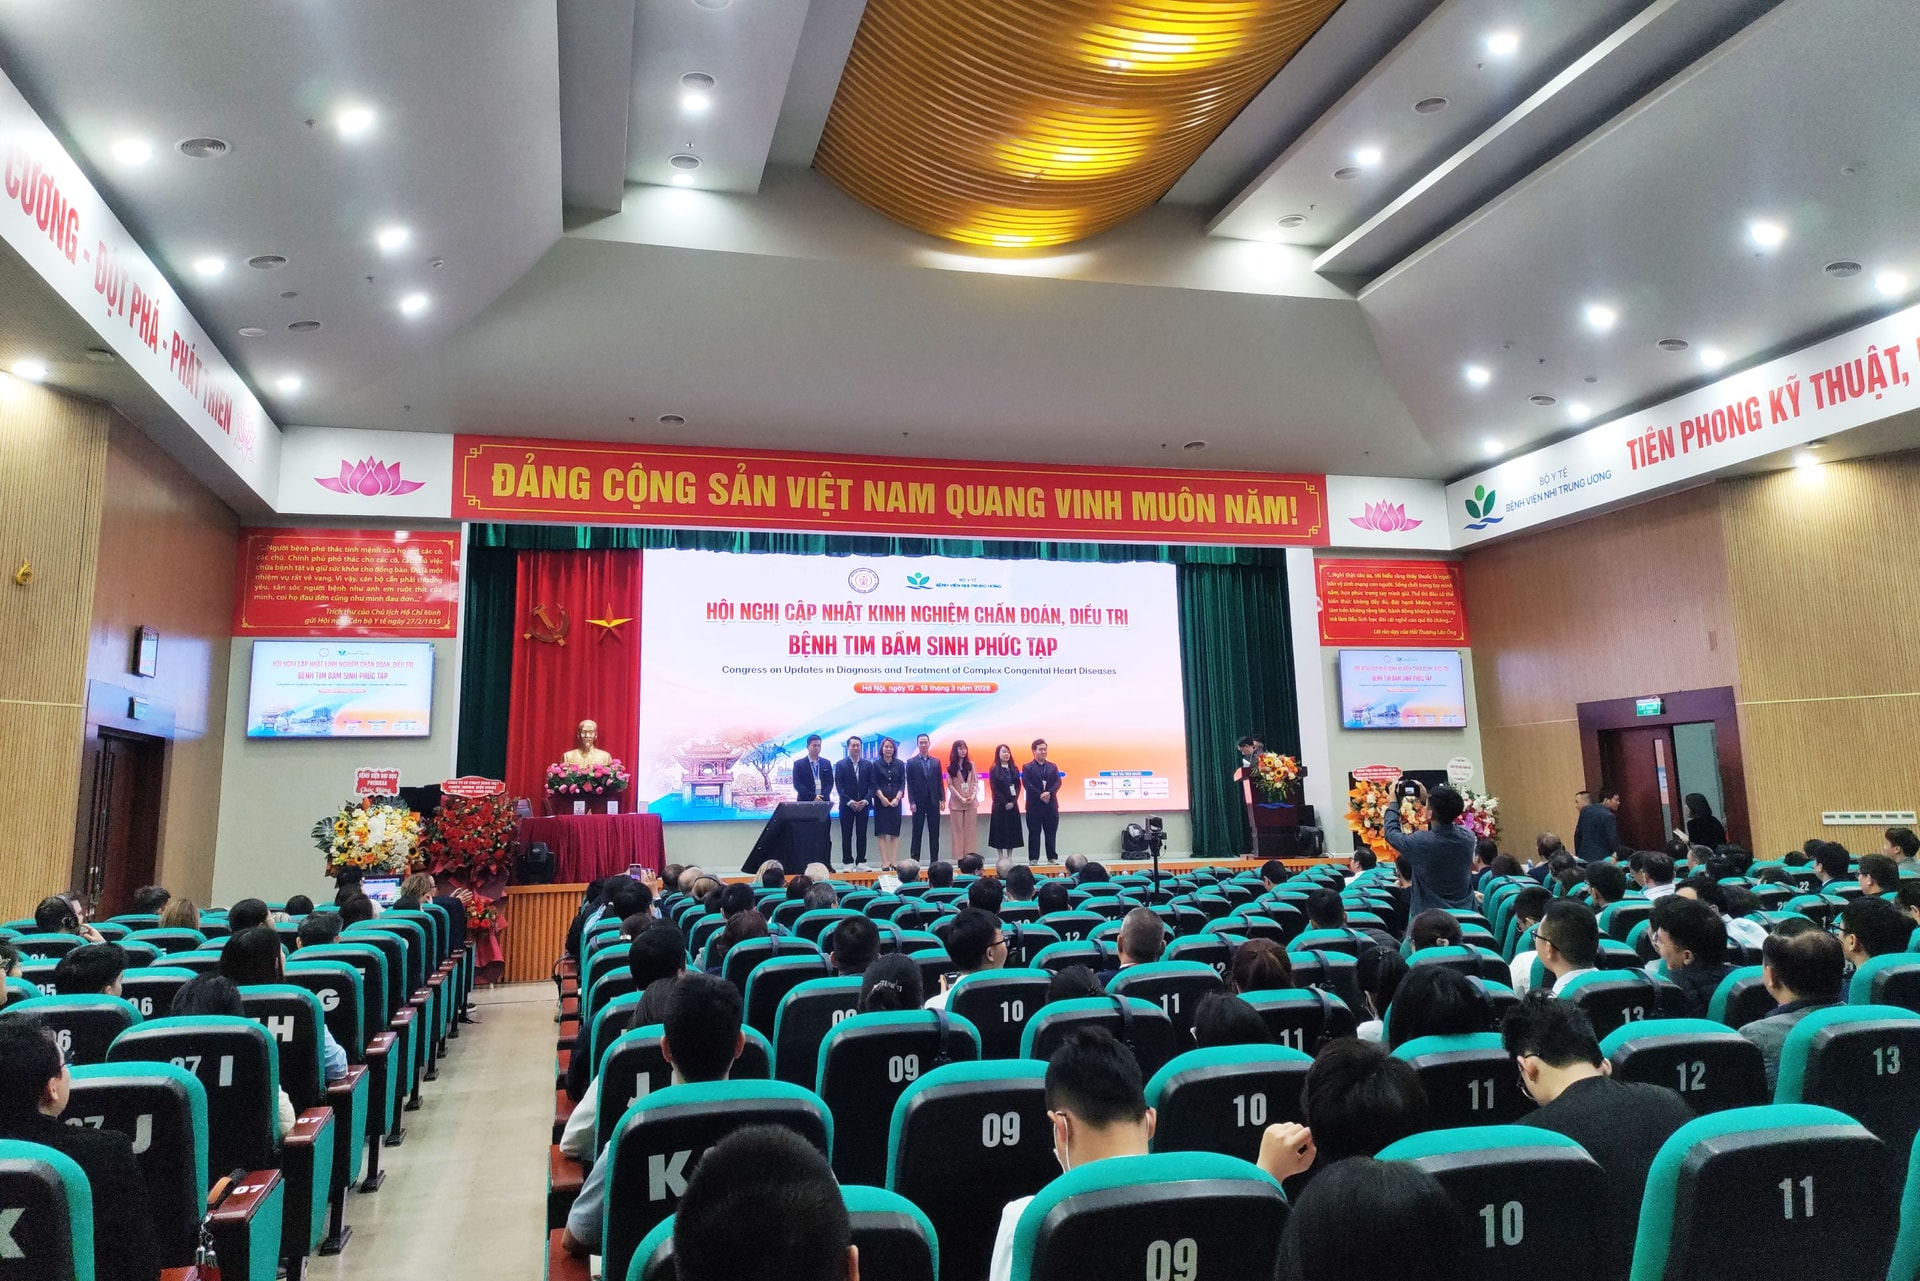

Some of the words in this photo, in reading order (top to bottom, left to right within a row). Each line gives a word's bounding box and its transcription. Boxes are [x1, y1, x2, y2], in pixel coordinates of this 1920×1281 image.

[129, 283, 159, 355] PHÁ
[170, 329, 202, 399] PHÁT
[1626, 425, 1676, 471] TIÊN
[1680, 396, 1762, 454] PHONG
[1768, 374, 1802, 425] KỸ
[1809, 344, 1909, 410] THUẬT,
[492, 452, 591, 500] ĐẢNG
[602, 462, 696, 510] CỘNG
[708, 462, 776, 507] SẢN
[786, 471, 853, 517] VIỆT
[863, 480, 936, 514] NAM
[945, 483, 1046, 519] QUANG
[1054, 488, 1123, 521] VINH
[1131, 486, 1215, 523] MUÔN
[1224, 488, 1299, 526] NĂM!
[1539, 472, 1550, 486] BỘ
[1551, 471, 1558, 480] Y
[1559, 465, 1568, 479] TẾ
[1505, 499, 1525, 513] BỆNH
[1526, 492, 1543, 506] VIỆN
[1544, 488, 1557, 500] NHI
[1558, 479, 1586, 495] TRUNG
[1586, 469, 1612, 486] ƯƠNG
[400, 576, 416, 584] phải
[289, 594, 298, 602] họ
[317, 617, 330, 625] Hội
[363, 617, 372, 625] bộ
[386, 609, 399, 617] tịch
[706, 598, 734, 623] HỘI
[740, 602, 779, 623] NGHỊ
[784, 600, 817, 624] CẬP
[822, 600, 863, 624] NHẬT
[868, 605, 906, 622] KINH
[911, 602, 969, 625] NGHIỆM
[1020, 604, 1065, 626] ĐOÁN,
[1106, 608, 1128, 627] TRỊ
[789, 631, 837, 658] BỆNH
[843, 635, 875, 655] TIM
[927, 635, 969, 656] SINH
[974, 632, 1021, 656] PHỨC
[1026, 636, 1058, 659] TẠP
[722, 665, 767, 675] Congress
[784, 665, 823, 675] Updates
[826, 666, 835, 674] in
[837, 665, 882, 675] Diagnosis
[884, 666, 901, 674] and
[904, 666, 950, 674] Treatment
[952, 666, 961, 674] of
[963, 666, 1001, 675] Complex
[1004, 667, 1051, 676] Congenital
[1053, 667, 1077, 675] Heart
[1079, 667, 1117, 675] Diseases
[873, 684, 887, 692] Nội,
[929, 684, 950, 692] tháng
[316, 988, 340, 1012] G
[1000, 1000, 1024, 1023] 10
[1160, 992, 1180, 1016] 11
[57, 1029, 72, 1050] 6
[268, 1015, 294, 1042] H
[1280, 1028, 1304, 1052] 11
[888, 1054, 920, 1083] 09
[1873, 1046, 1900, 1076] 13
[1676, 1060, 1706, 1092] 12
[1468, 1078, 1495, 1110] 11
[297, 1116, 322, 1125] 07
[1233, 1093, 1267, 1127] 10
[132, 1113, 153, 1154] J
[982, 1111, 1021, 1148] 09
[648, 1149, 693, 1201] K
[232, 1184, 266, 1195] 07
[1778, 1176, 1815, 1220] 11
[1479, 1200, 1525, 1248] 10
[1146, 1237, 1198, 1281] 09
